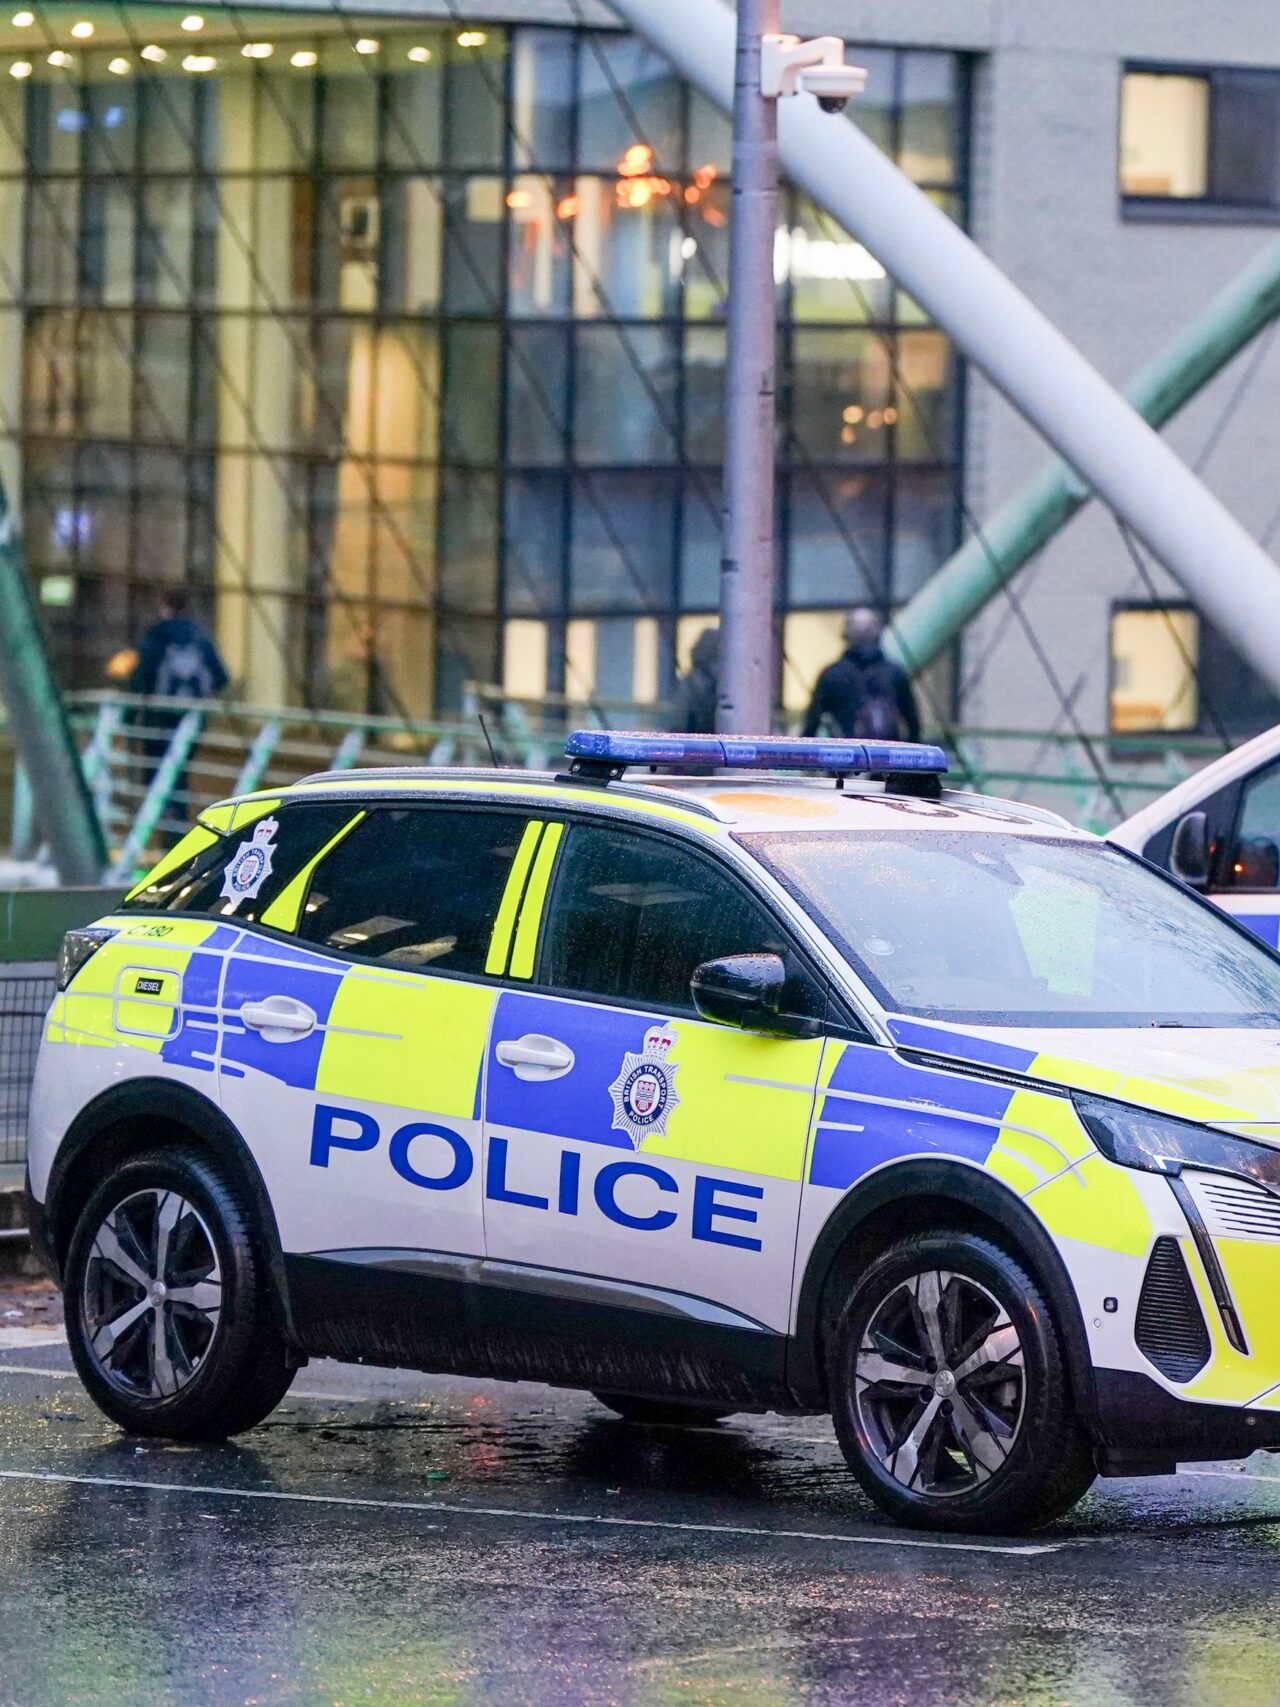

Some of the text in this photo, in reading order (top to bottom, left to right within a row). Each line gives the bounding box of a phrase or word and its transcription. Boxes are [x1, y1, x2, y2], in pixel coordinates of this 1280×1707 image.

[137, 981, 160, 992] DIESEL
[624, 1065, 667, 1109] BRITISH TRANSPORT
[628, 1110, 654, 1124] POLICE
[309, 1103, 764, 1252] POLICE
